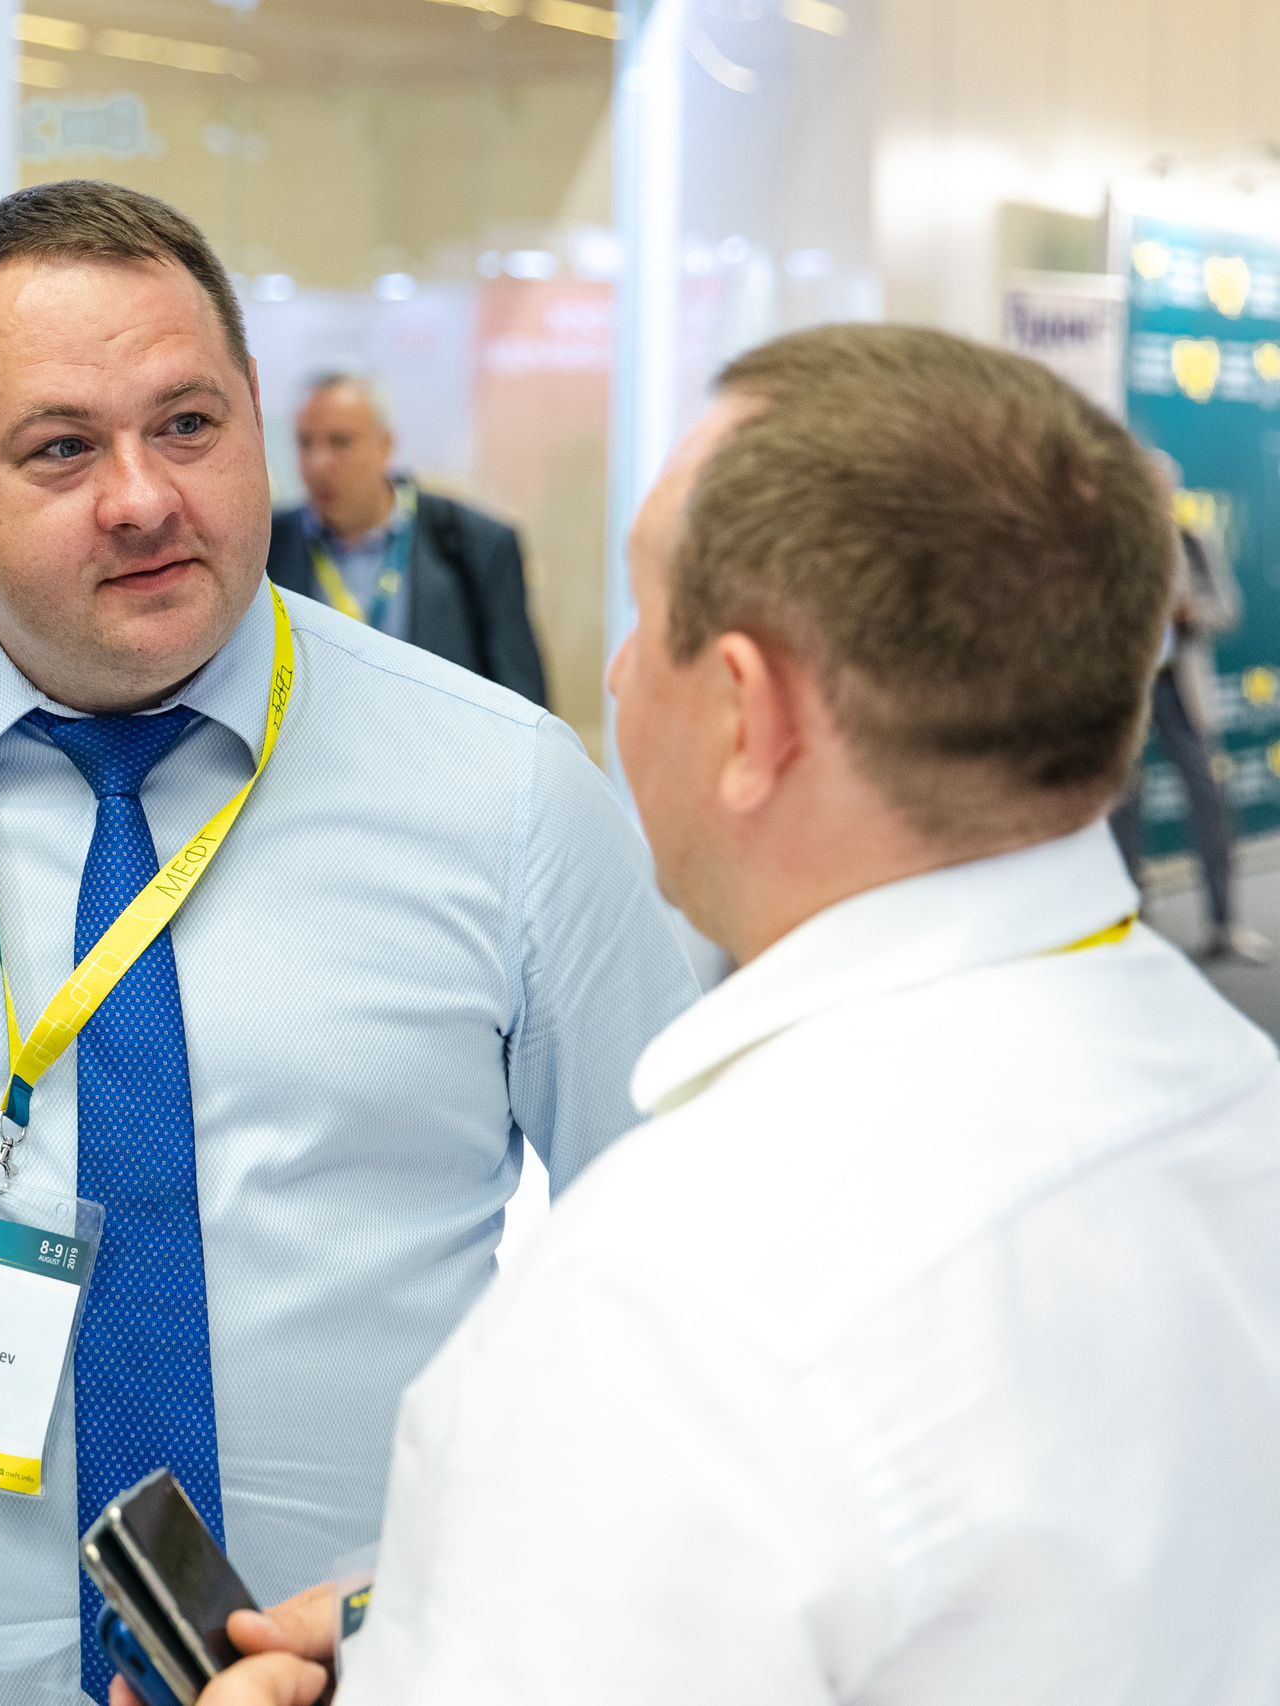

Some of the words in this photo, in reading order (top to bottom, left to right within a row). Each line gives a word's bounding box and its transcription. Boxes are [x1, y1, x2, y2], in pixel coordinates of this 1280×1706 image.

[155, 831, 217, 900] МЕФТ
[40, 1240, 64, 1258] 8-9
[37, 1255, 61, 1266] AUGUST
[66, 1247, 79, 1270] 2019
[6, 1471, 35, 1483] meft.info
